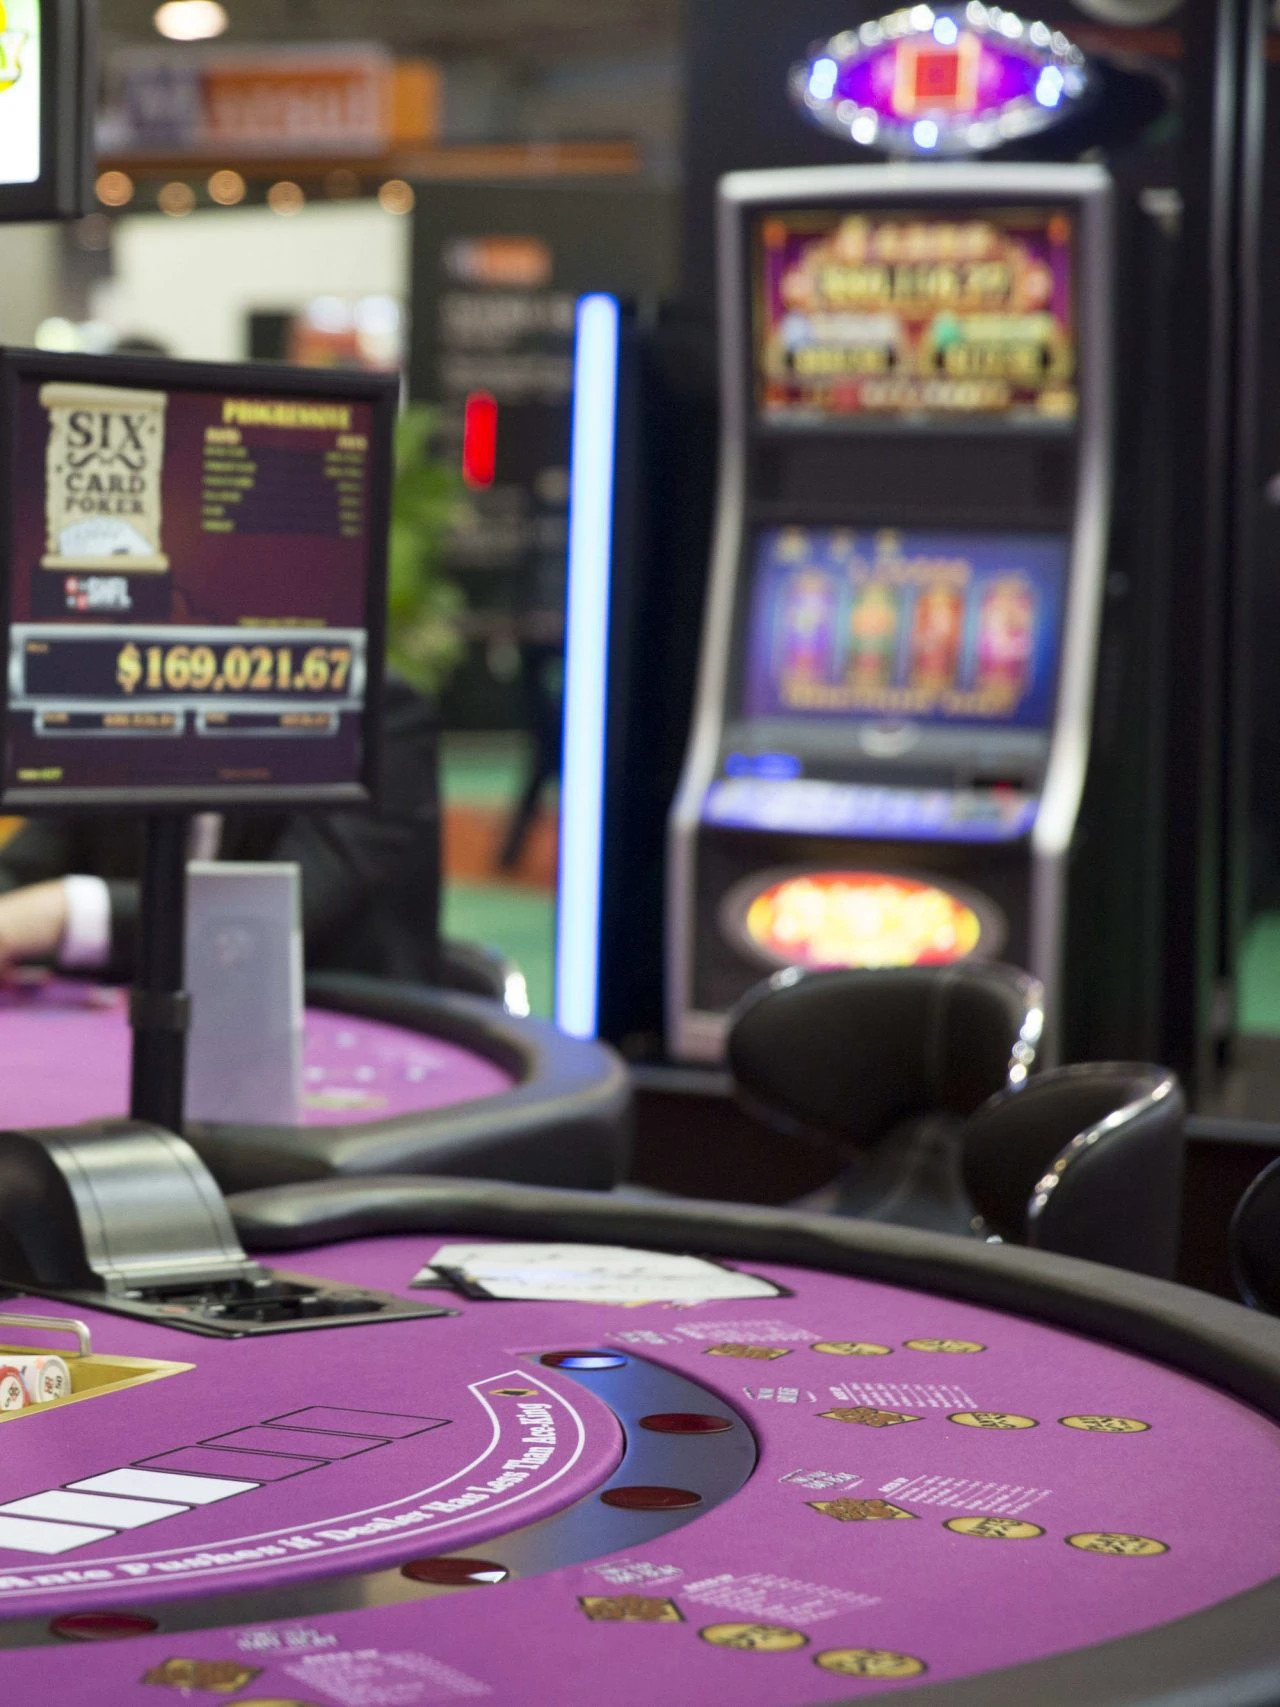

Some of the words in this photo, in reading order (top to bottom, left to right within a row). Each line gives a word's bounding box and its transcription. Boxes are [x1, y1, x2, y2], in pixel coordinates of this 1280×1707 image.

[67, 410, 147, 450] SIX
[65, 473, 146, 494] CARD
[64, 497, 145, 515] POKER
[117, 642, 351, 693] $169,021.67
[515, 1403, 557, 1445] Ace-King
[501, 1446, 556, 1470] Than
[465, 1471, 531, 1494] Less
[419, 1490, 490, 1514] Has
[313, 1510, 434, 1542] Dealer
[117, 1543, 287, 1576] Pushes
